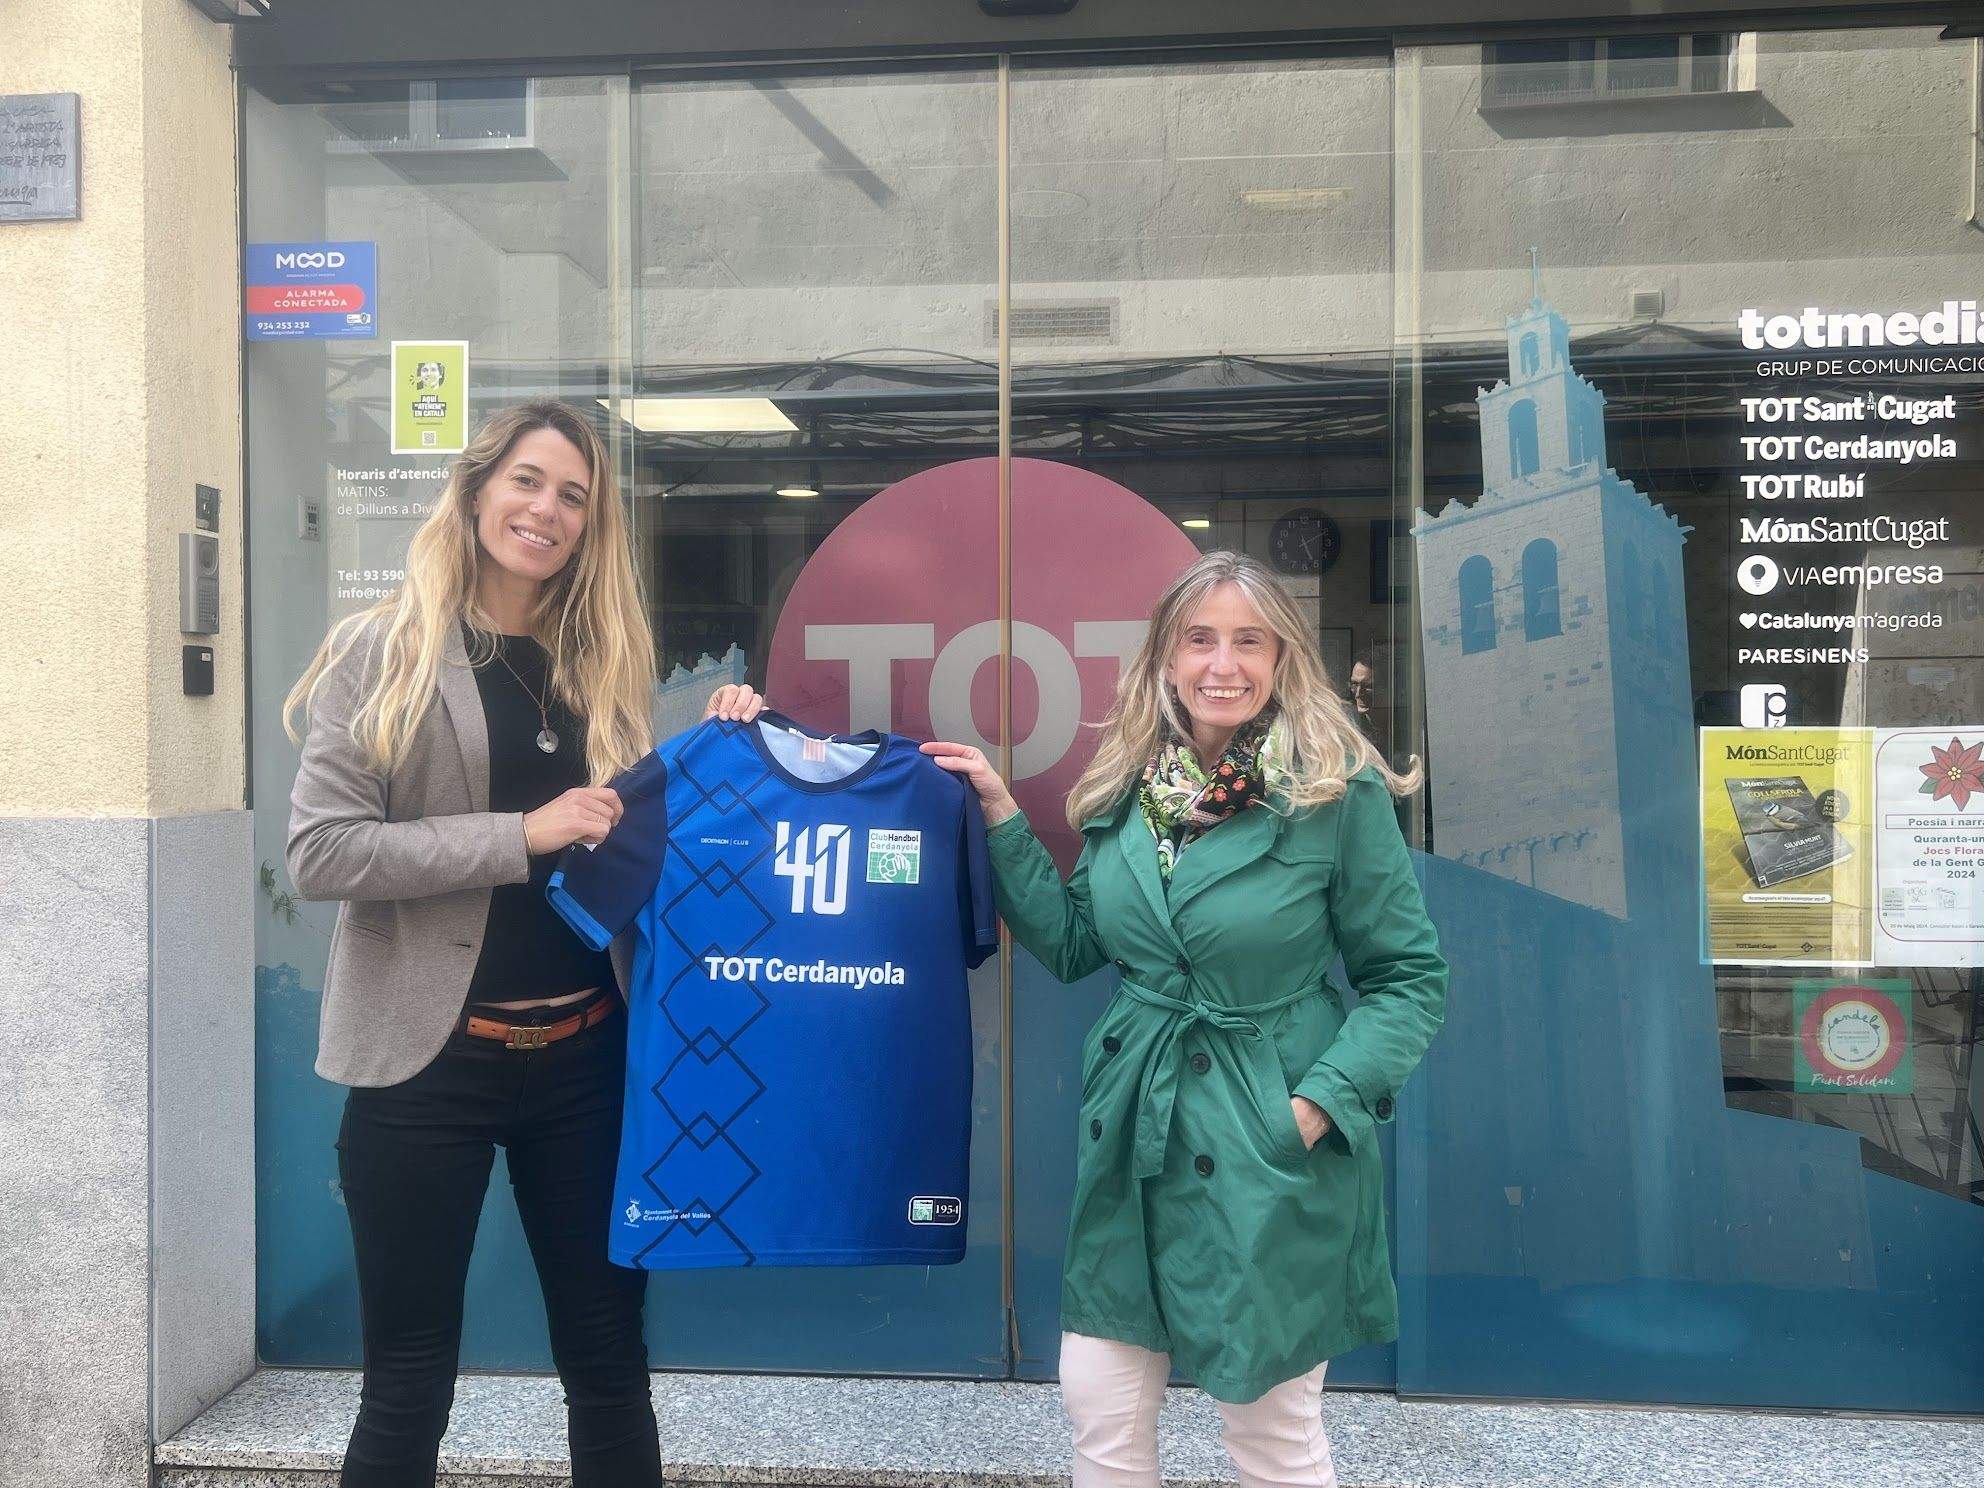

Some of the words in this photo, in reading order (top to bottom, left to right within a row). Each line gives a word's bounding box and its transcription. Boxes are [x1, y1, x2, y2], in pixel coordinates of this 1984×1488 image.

[275, 252, 346, 269] MOOD
[286, 290, 336, 298] ALARMA
[258, 321, 274, 330] 934
[276, 321, 292, 330] 253
[294, 321, 311, 329] 232
[1738, 300, 1984, 350] totmedi
[1756, 360, 1812, 376] GRUP
[1816, 360, 1843, 375] DE
[1740, 397, 1801, 422] TOT
[1803, 396, 1865, 421] Sant
[1877, 394, 1956, 424] Cugat
[1740, 436, 1801, 460] TOT
[1804, 433, 1957, 464] Cerdanyola
[337, 468, 386, 480] Horaris
[388, 467, 449, 479] d'atenció
[337, 486, 389, 498] MATINS:
[1740, 474, 1801, 500] TOT
[1804, 472, 1866, 498] Rubí
[337, 504, 352, 515] de
[356, 503, 398, 515] Dilluns
[401, 506, 409, 514] a
[1740, 516, 1949, 549] MónSantCugat
[337, 570, 360, 581] Tel:
[363, 570, 379, 581] 93
[382, 570, 405, 580] 590
[1783, 564, 1944, 590] VIAempresa
[1726, 745, 1850, 764] MónSantCugat
[1908, 818, 1947, 826] Poesia
[870, 842, 919, 851] Cerdanyola
[1923, 847, 1951, 855] Jocs
[774, 821, 851, 915] 40
[1912, 859, 1927, 867] de
[1931, 859, 1942, 867] la
[1945, 858, 1974, 867] Gent
[1947, 870, 1976, 879] 2024
[705, 956, 763, 982] TOT
[765, 958, 905, 990] Cerdanyola
[1810, 1073, 1843, 1087] Punt
[1845, 1073, 1897, 1087] Solidari
[936, 1204, 959, 1214] 1954
